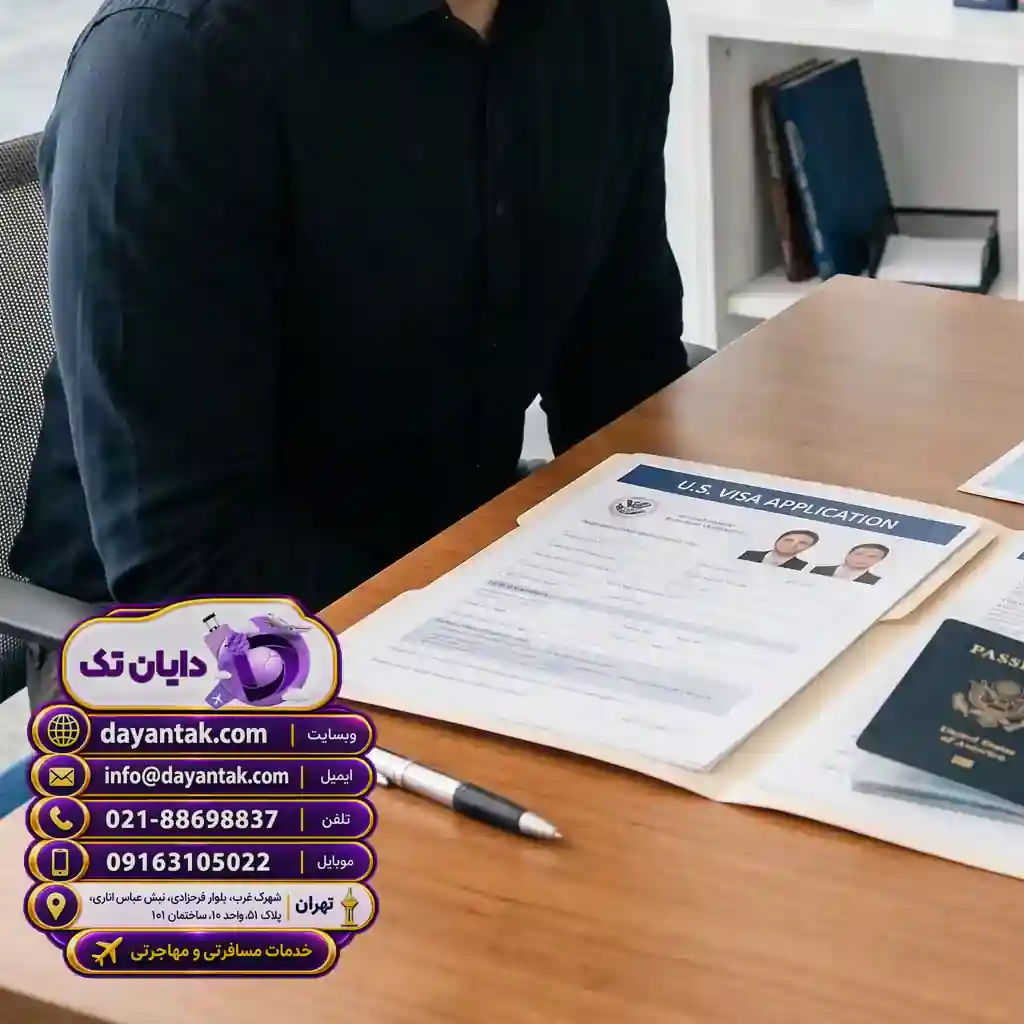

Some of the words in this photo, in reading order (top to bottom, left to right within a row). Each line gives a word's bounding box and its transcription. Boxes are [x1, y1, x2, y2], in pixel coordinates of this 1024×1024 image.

[677, 480, 711, 496] U.S.
[719, 487, 763, 505] VISA
[763, 497, 899, 530] APPLICATION
